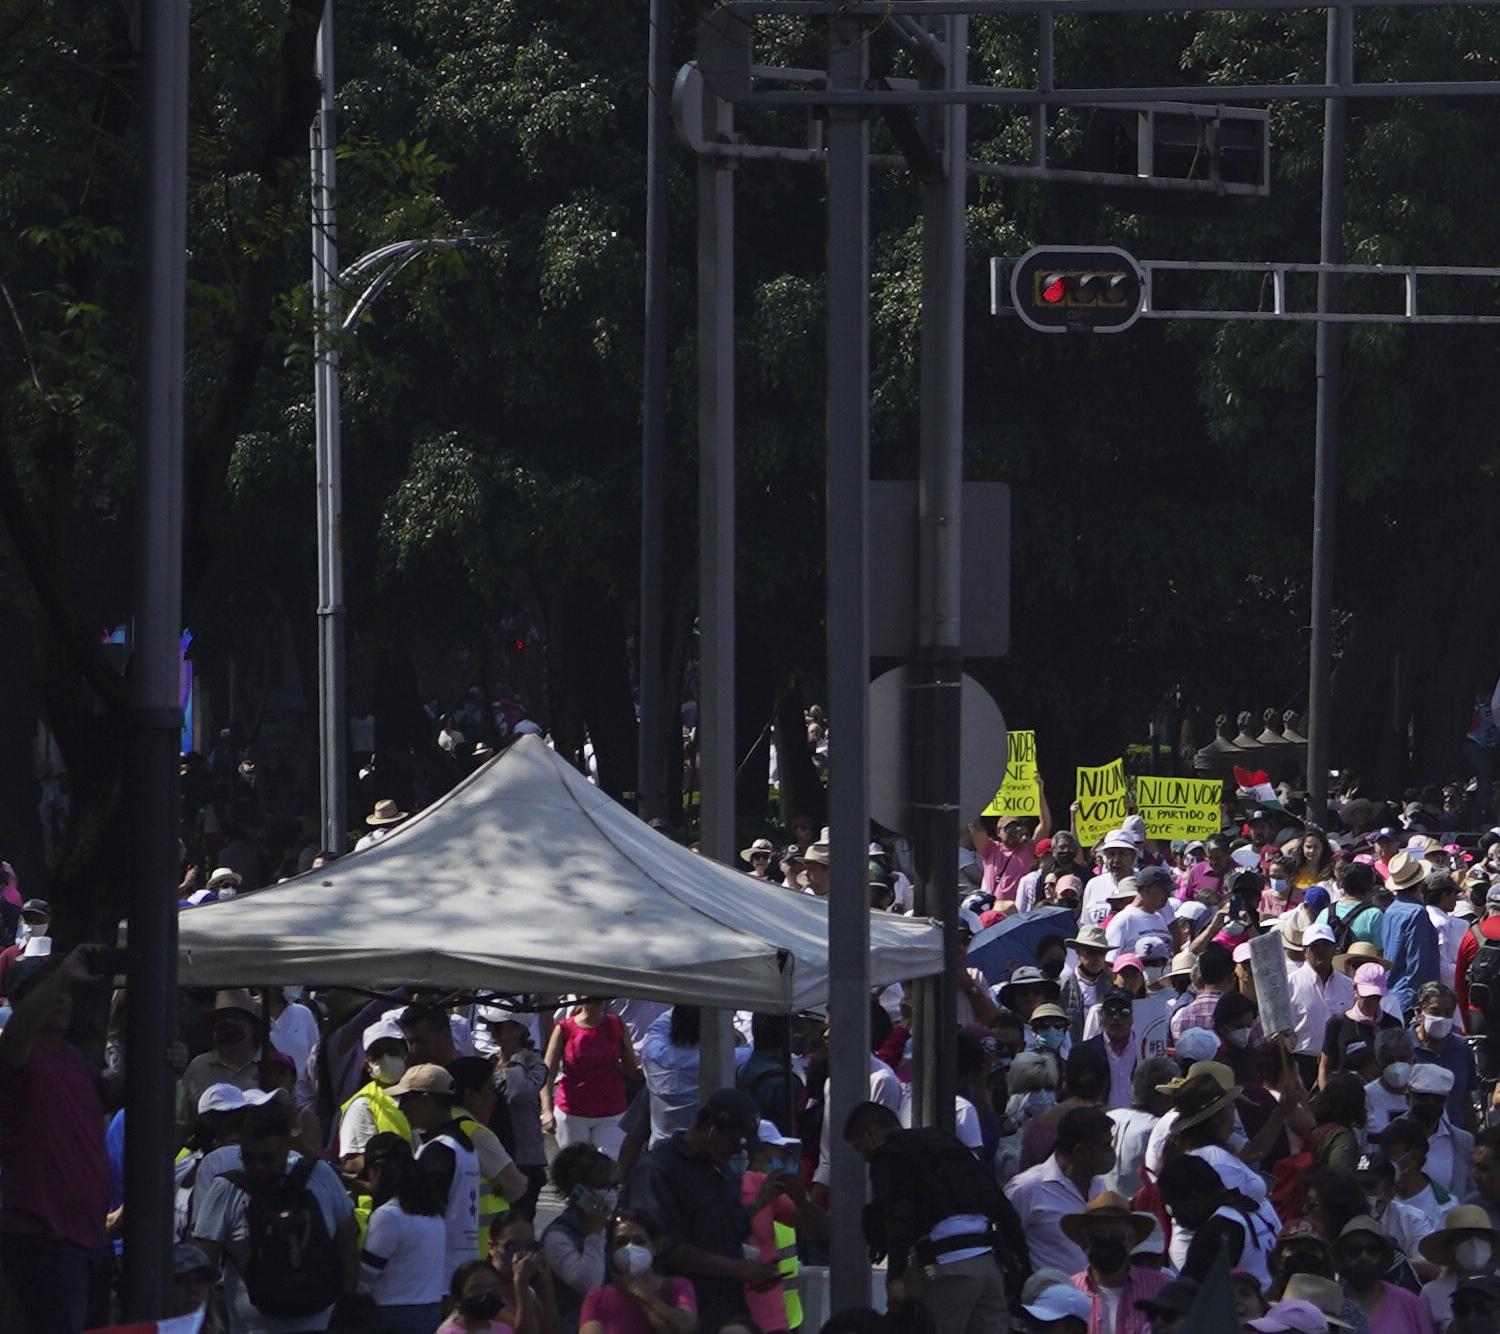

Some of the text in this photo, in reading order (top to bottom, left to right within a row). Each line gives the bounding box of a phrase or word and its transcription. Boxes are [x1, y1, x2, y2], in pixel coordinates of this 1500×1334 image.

[1079, 771, 1104, 797] NI
[1140, 779, 1163, 806] NI
[1166, 779, 1188, 806] UN
[1079, 795, 1127, 822] VOTO
[1157, 810, 1204, 822] PARTIDO
